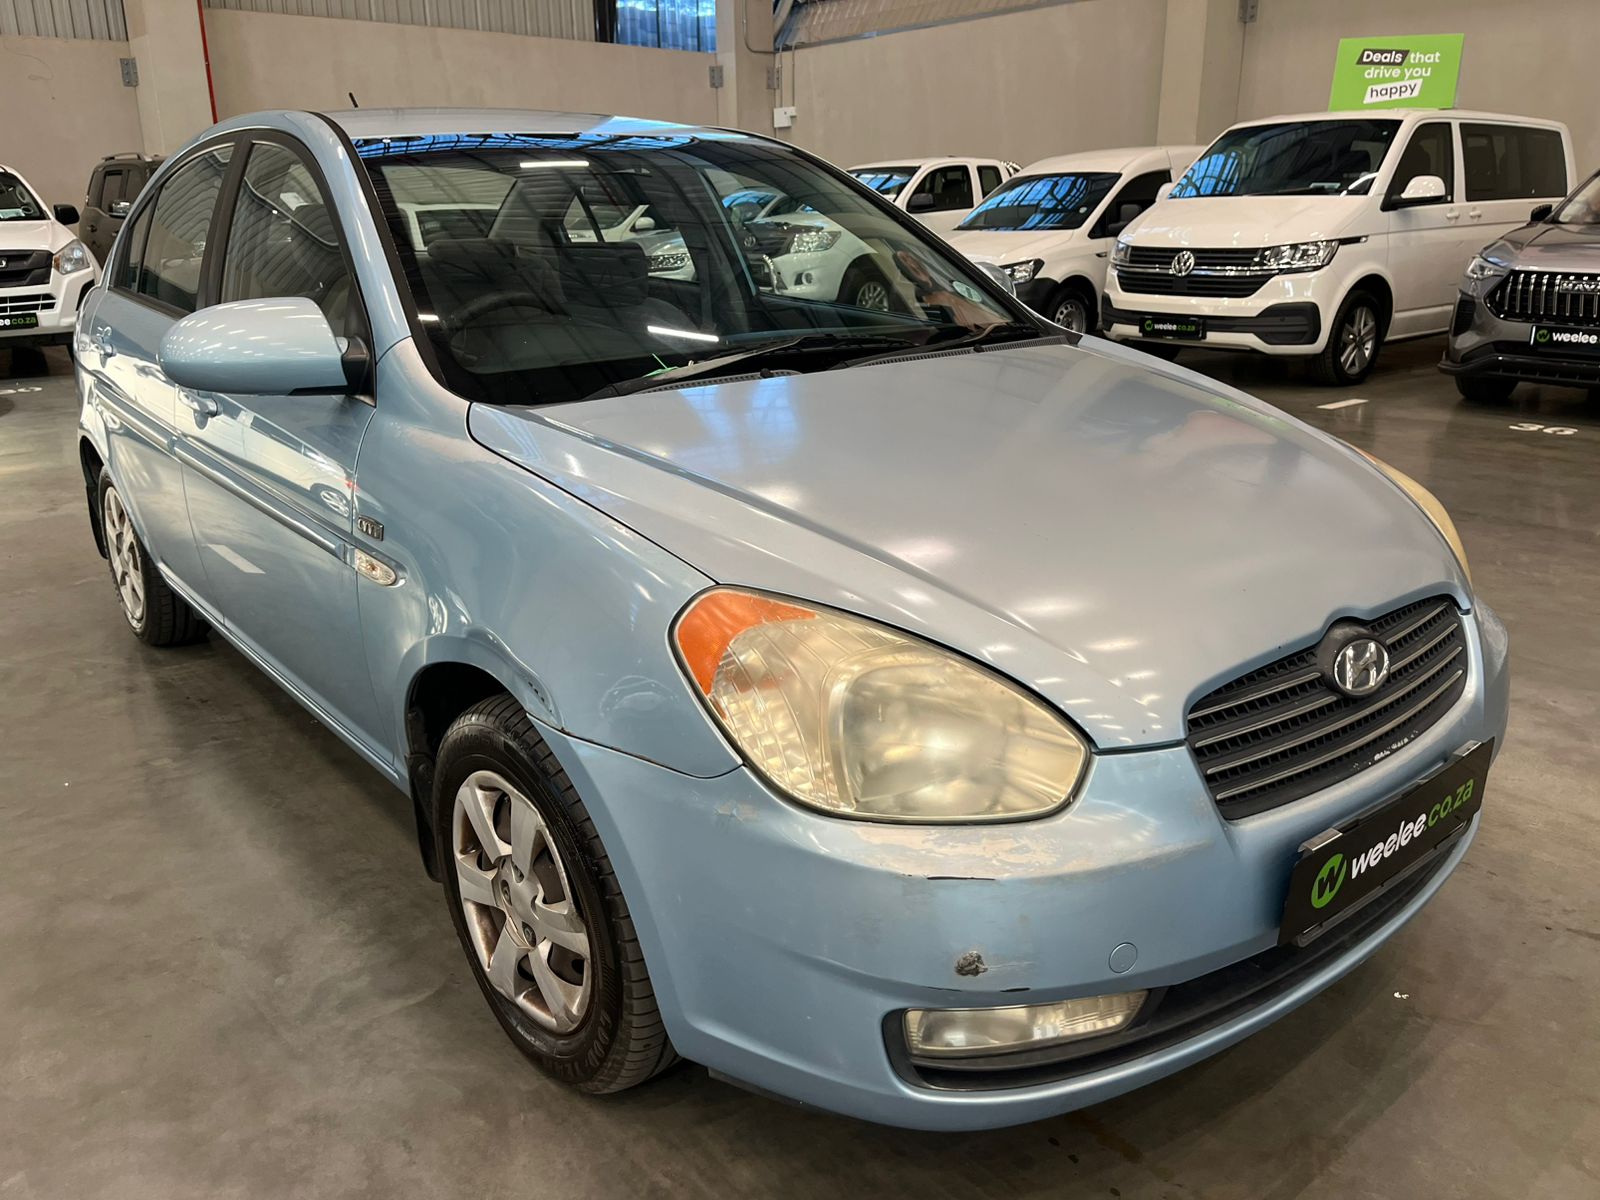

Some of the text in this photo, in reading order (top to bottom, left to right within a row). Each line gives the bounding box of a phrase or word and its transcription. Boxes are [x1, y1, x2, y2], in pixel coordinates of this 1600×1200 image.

[1362, 51, 1441, 63] Deals that
[1364, 66, 1432, 80] drive you
[1370, 83, 1418, 98] happy
[1154, 323, 1196, 331] weelee.co.za
[1351, 778, 1474, 880] weelee.co.za
